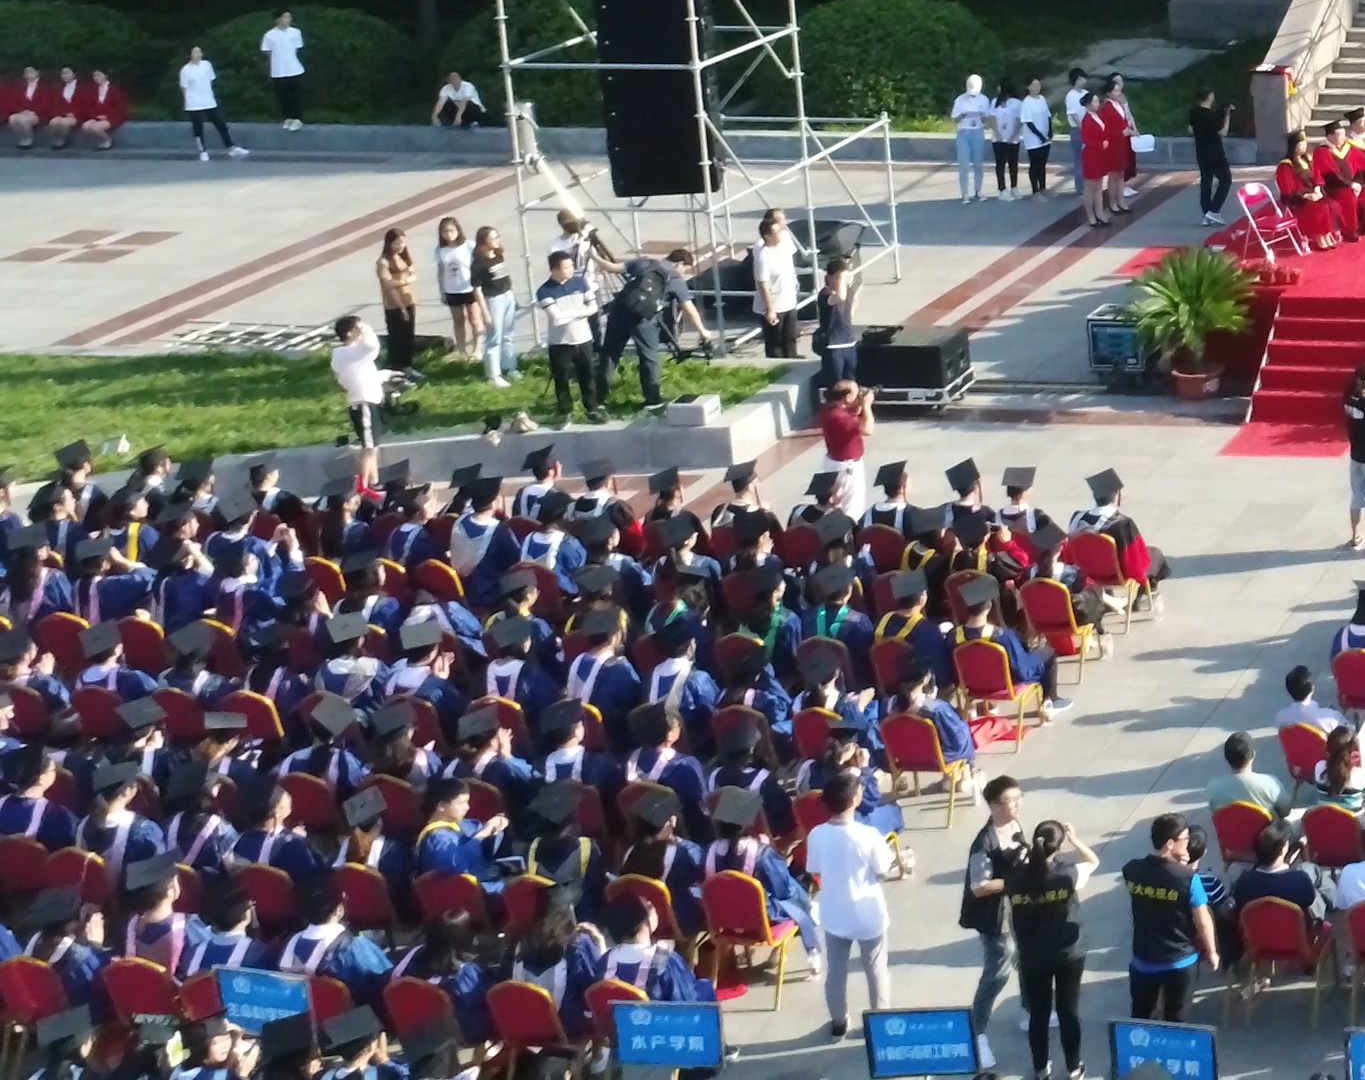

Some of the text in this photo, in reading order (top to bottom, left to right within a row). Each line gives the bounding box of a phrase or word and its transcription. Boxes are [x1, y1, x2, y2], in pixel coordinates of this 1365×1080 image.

[631, 1034, 705, 1052] 水产学院
[1129, 1055, 1201, 1077] 软学院
